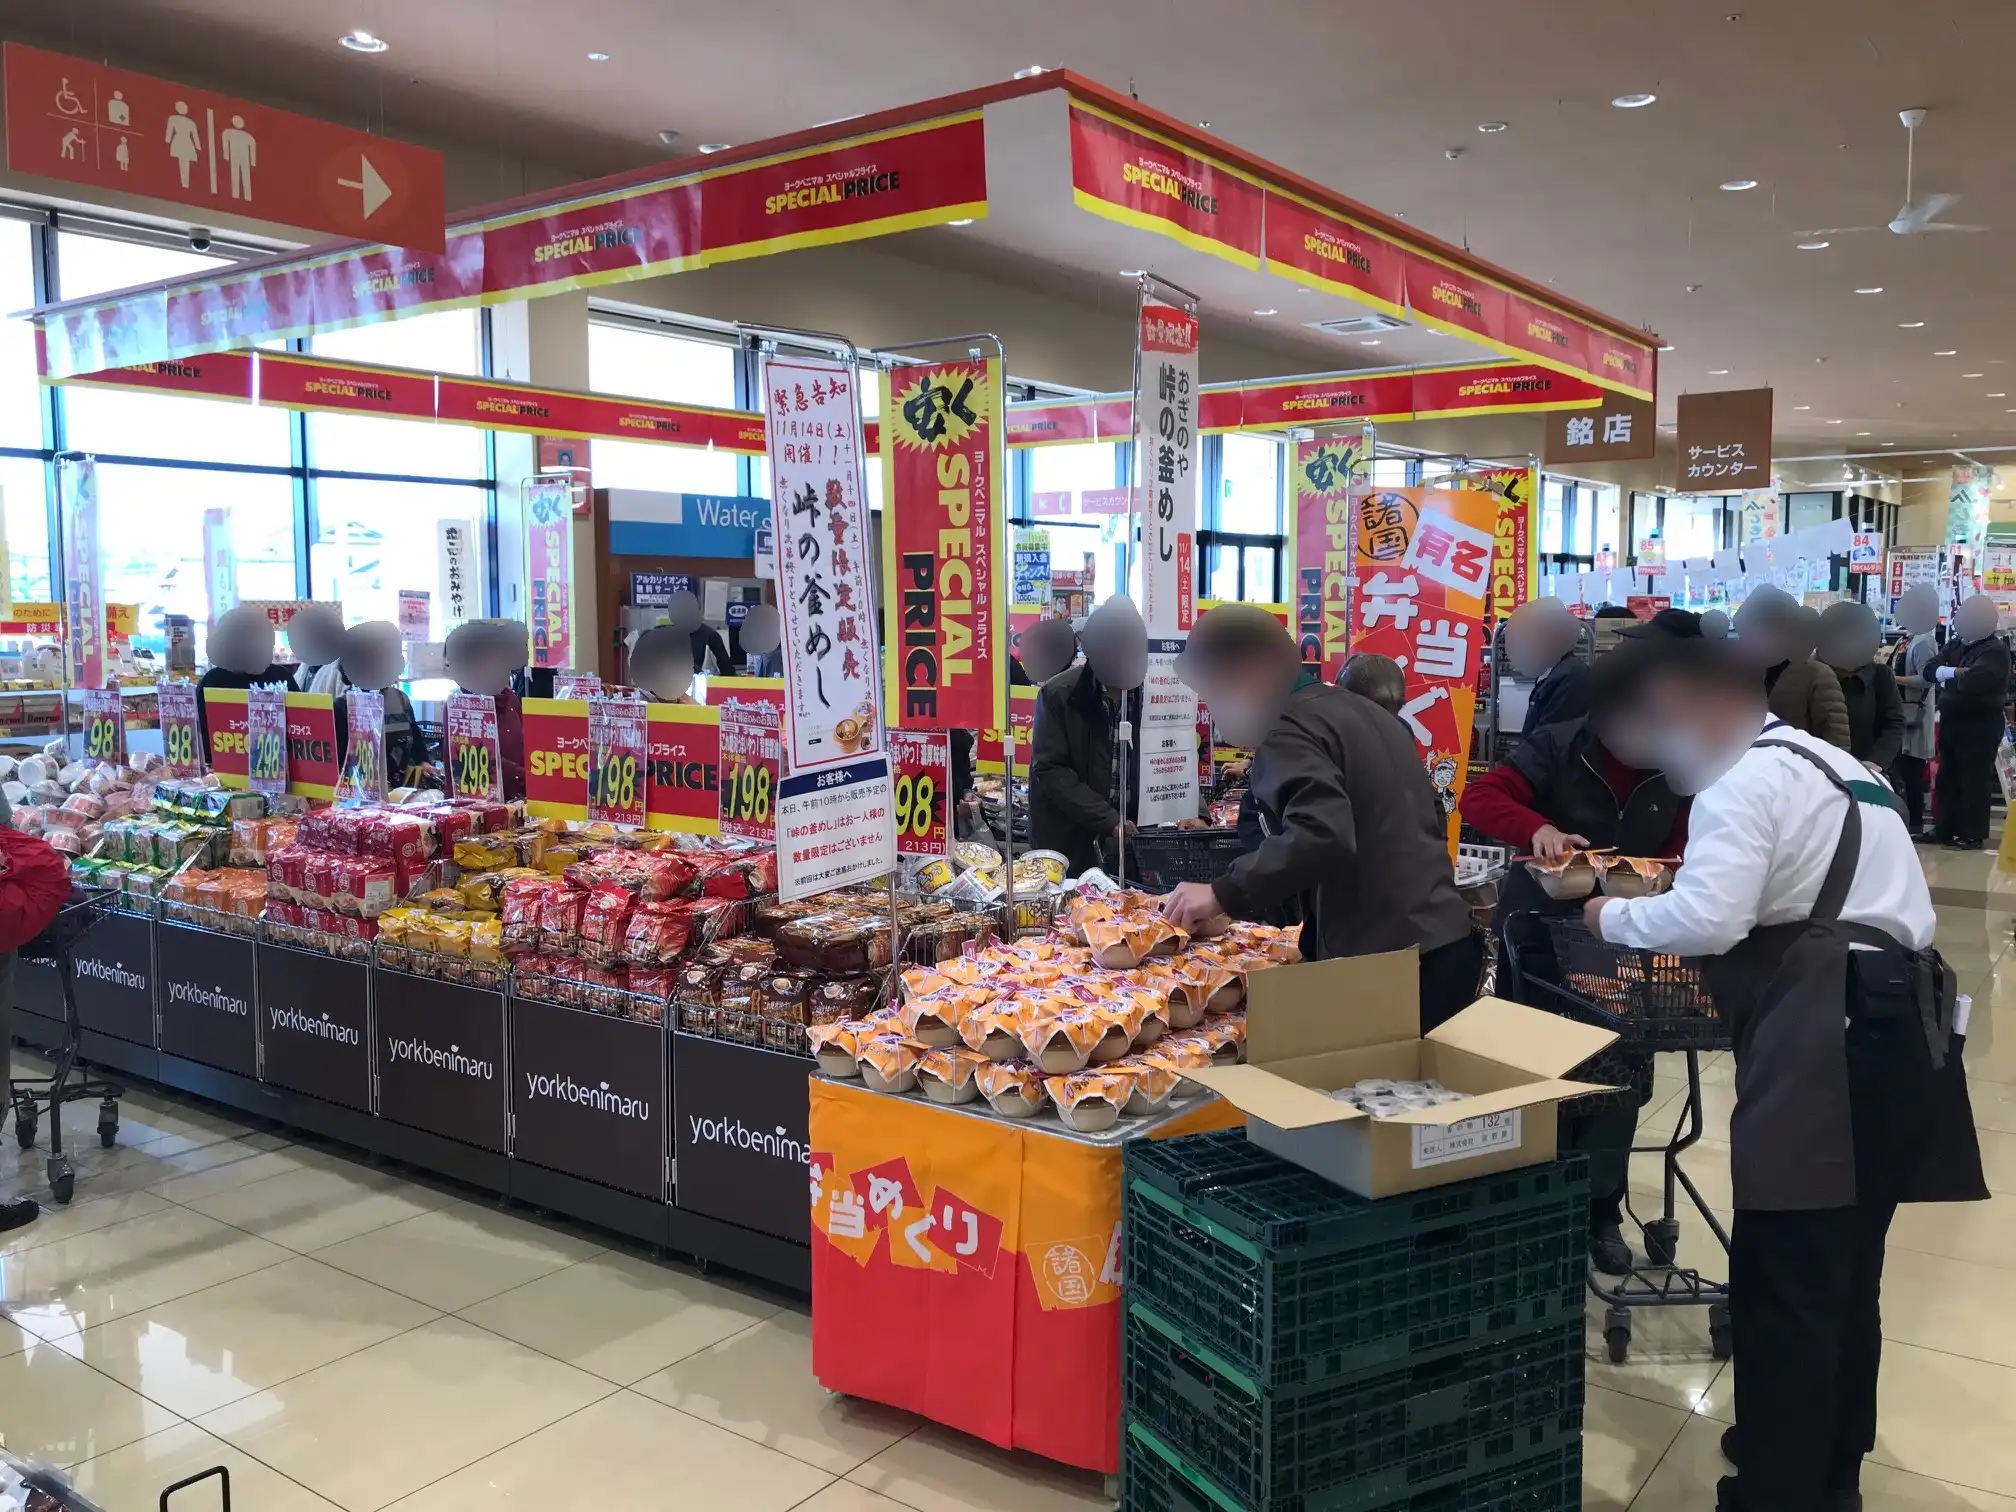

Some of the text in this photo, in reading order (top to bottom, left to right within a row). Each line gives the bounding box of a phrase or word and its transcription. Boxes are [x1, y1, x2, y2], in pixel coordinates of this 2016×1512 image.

[765, 171, 900, 215] SPECIAL PRICE
[784, 164, 878, 192] ヨークベニマル スペシャルプライス
[1123, 163, 1218, 215] SPECIAL PRICE
[534, 226, 640, 263] SPECIAL PRICE
[1304, 235, 1371, 275] SPECIAL PRICE
[352, 276, 401, 298] SPECIAL
[1432, 287, 1463, 309] SPECIAL
[1463, 298, 1482, 317] PRICE
[1528, 323, 1552, 343] SPECIAL
[1552, 332, 1568, 348] PRICE
[158, 362, 202, 378] PRICE
[305, 381, 356, 396] SPECIAL
[357, 387, 392, 400] PRICE
[774, 376, 848, 417] 緊急告知
[1282, 395, 1365, 411] SPECIAL PRICE
[1458, 379, 1551, 396] SPECIAL PRICE
[476, 400, 519, 414] SPECIAL
[519, 406, 549, 417] PRICE
[618, 417, 681, 432] SPECIAL PRICE
[1177, 369, 1190, 478] おぎのや
[738, 431, 766, 441] SPECIA
[1031, 421, 1058, 431] PRICE
[1566, 414, 1633, 446] 銘店
[1158, 361, 1176, 562] 峠の釜めし
[1688, 443, 1746, 460] サービス
[1688, 463, 1758, 478] カウンター
[697, 498, 759, 528] Water
[974, 451, 988, 660] ヨークベニマル スペシャル プライス
[1416, 523, 1488, 583] 有名
[1517, 516, 1525, 564] ヨークベニマル
[1640, 540, 1654, 551] 85
[1853, 535, 1869, 546] 84
[937, 453, 973, 687] SPECIAL
[1016, 553, 1048, 563] 新規入会
[1493, 517, 1516, 627] SPECIA
[545, 530, 562, 647] SPECIAL
[636, 574, 689, 585] アルカリイオン水
[792, 481, 832, 709] 峠の釜めし
[825, 478, 861, 681] 数量限定販売
[1324, 499, 1347, 664] SPECIAL
[13, 607, 51, 617] のために
[533, 578, 548, 663] PRICE
[903, 552, 937, 718] PRICE
[1361, 571, 1470, 747] 弁当ぐ
[88, 718, 115, 759] 98
[449, 718, 496, 739] ラ王醤油
[168, 724, 192, 767] 98
[256, 734, 280, 779] 298
[459, 744, 490, 796] 298
[596, 749, 636, 810] 198
[635, 801, 644, 813] 円
[816, 770, 853, 788] お客様へ
[1200, 764, 1211, 776] 円
[1468, 765, 1489, 773] PRICE
[729, 762, 770, 824] 198
[781, 784, 887, 816] 本日、午前10時から販売予定の
[895, 774, 945, 840] 98 円
[615, 812, 644, 825] 213円)
[786, 807, 885, 839] 「峠の釜めし」はお一人様の
[793, 832, 883, 864] 数量限定はございません
[905, 841, 946, 854] 213円)
[75, 956, 145, 991] yorkbenimaru
[168, 980, 247, 1016] yorkbenimaru
[269, 1006, 359, 1045] yorkbenimaru
[388, 1036, 493, 1080] yorkbenimaru
[527, 1071, 649, 1121] yorkbenimaru
[1481, 1114, 1501, 1129] 132
[690, 1113, 810, 1165] yorkbenima
[1449, 1138, 1474, 1149] 株式会社
